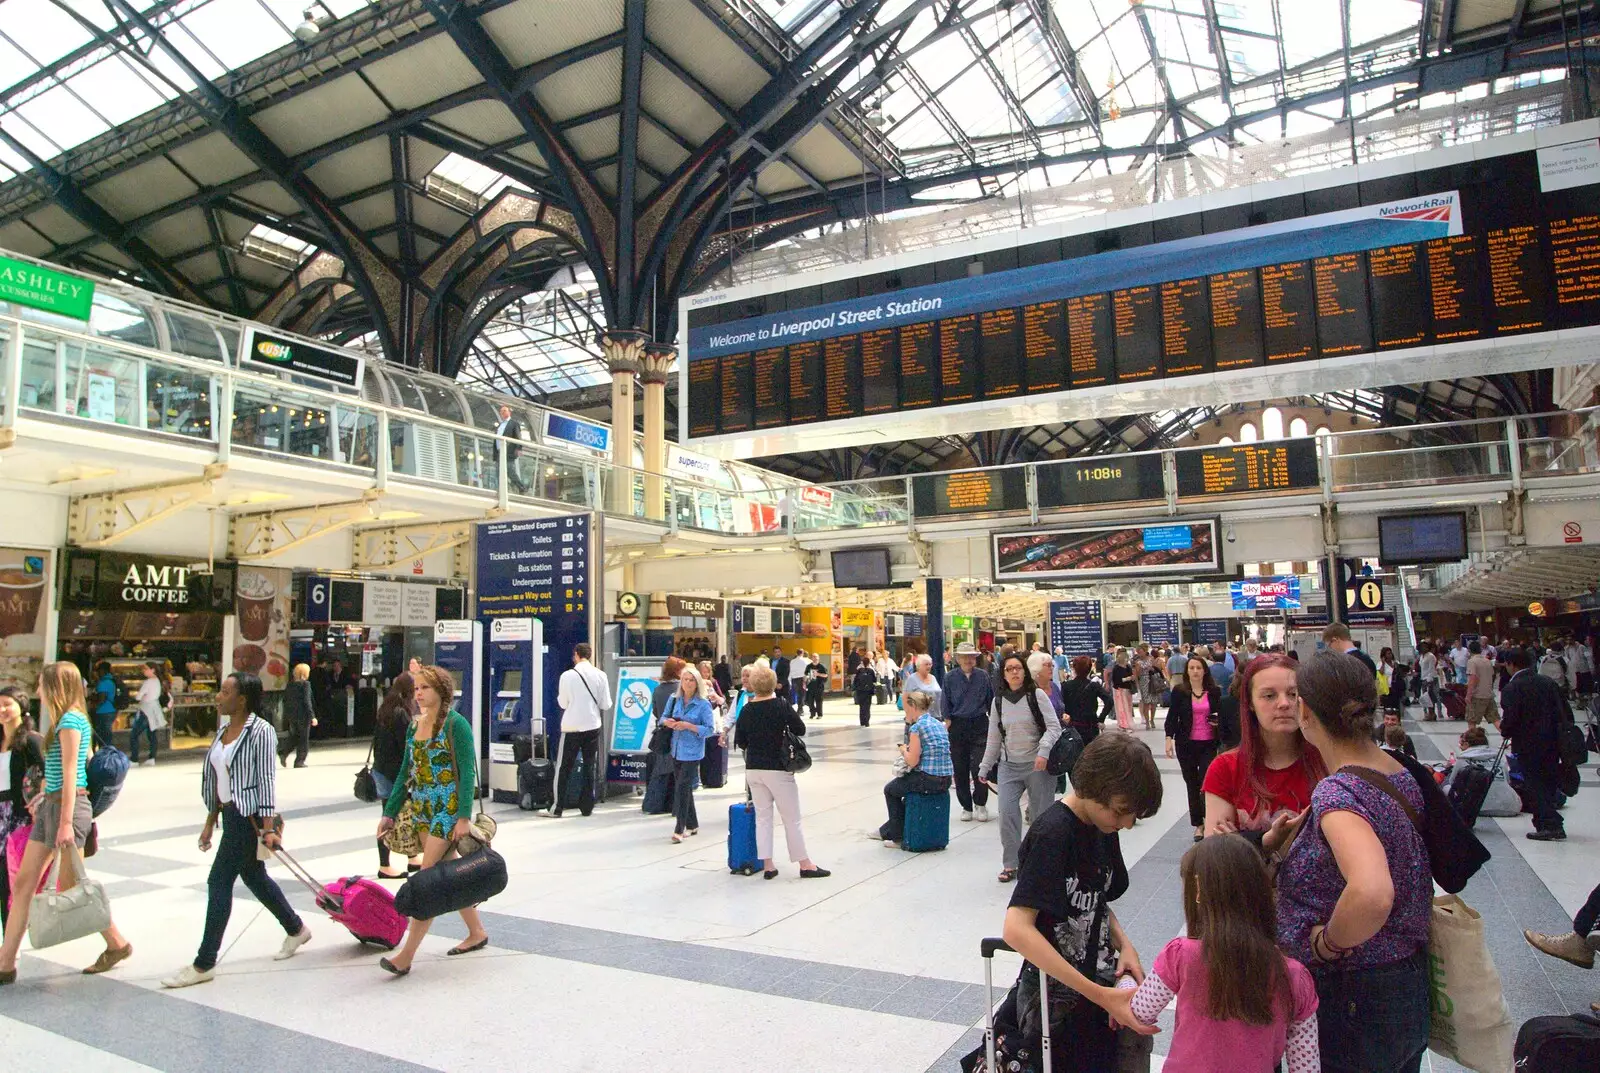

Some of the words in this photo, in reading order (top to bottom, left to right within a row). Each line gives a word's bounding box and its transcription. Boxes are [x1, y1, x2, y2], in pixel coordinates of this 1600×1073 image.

[0, 267, 82, 299] ASHLEY
[691, 293, 727, 306] Departures
[709, 331, 756, 348] Welcome
[758, 329, 770, 340] to
[771, 312, 835, 338] Liverpool
[837, 305, 883, 327] Street
[886, 296, 942, 318] Station
[259, 343, 291, 360] LUSH
[574, 424, 604, 447] Books
[511, 523, 536, 532] Stansted
[535, 520, 558, 530] Express
[531, 535, 553, 544] Toilets
[489, 552, 511, 561] Tickets
[511, 551, 517, 560] &
[517, 549, 553, 560] Information
[518, 564, 530, 573] Bus
[530, 563, 553, 573] station
[122, 563, 191, 588] AMT
[512, 577, 553, 588] Underground
[121, 587, 189, 604] COFFEE
[312, 584, 325, 604] 6
[1242, 585, 1260, 596] sky
[1260, 583, 1288, 593] NEWS
[524, 592, 539, 601] Way
[524, 605, 539, 614] Way
[539, 605, 552, 613] out
[679, 600, 694, 610] TIE
[694, 602, 716, 612] RACK
[735, 608, 741, 622] 8
[795, 612, 801, 624] 9
[619, 770, 641, 779] Street
